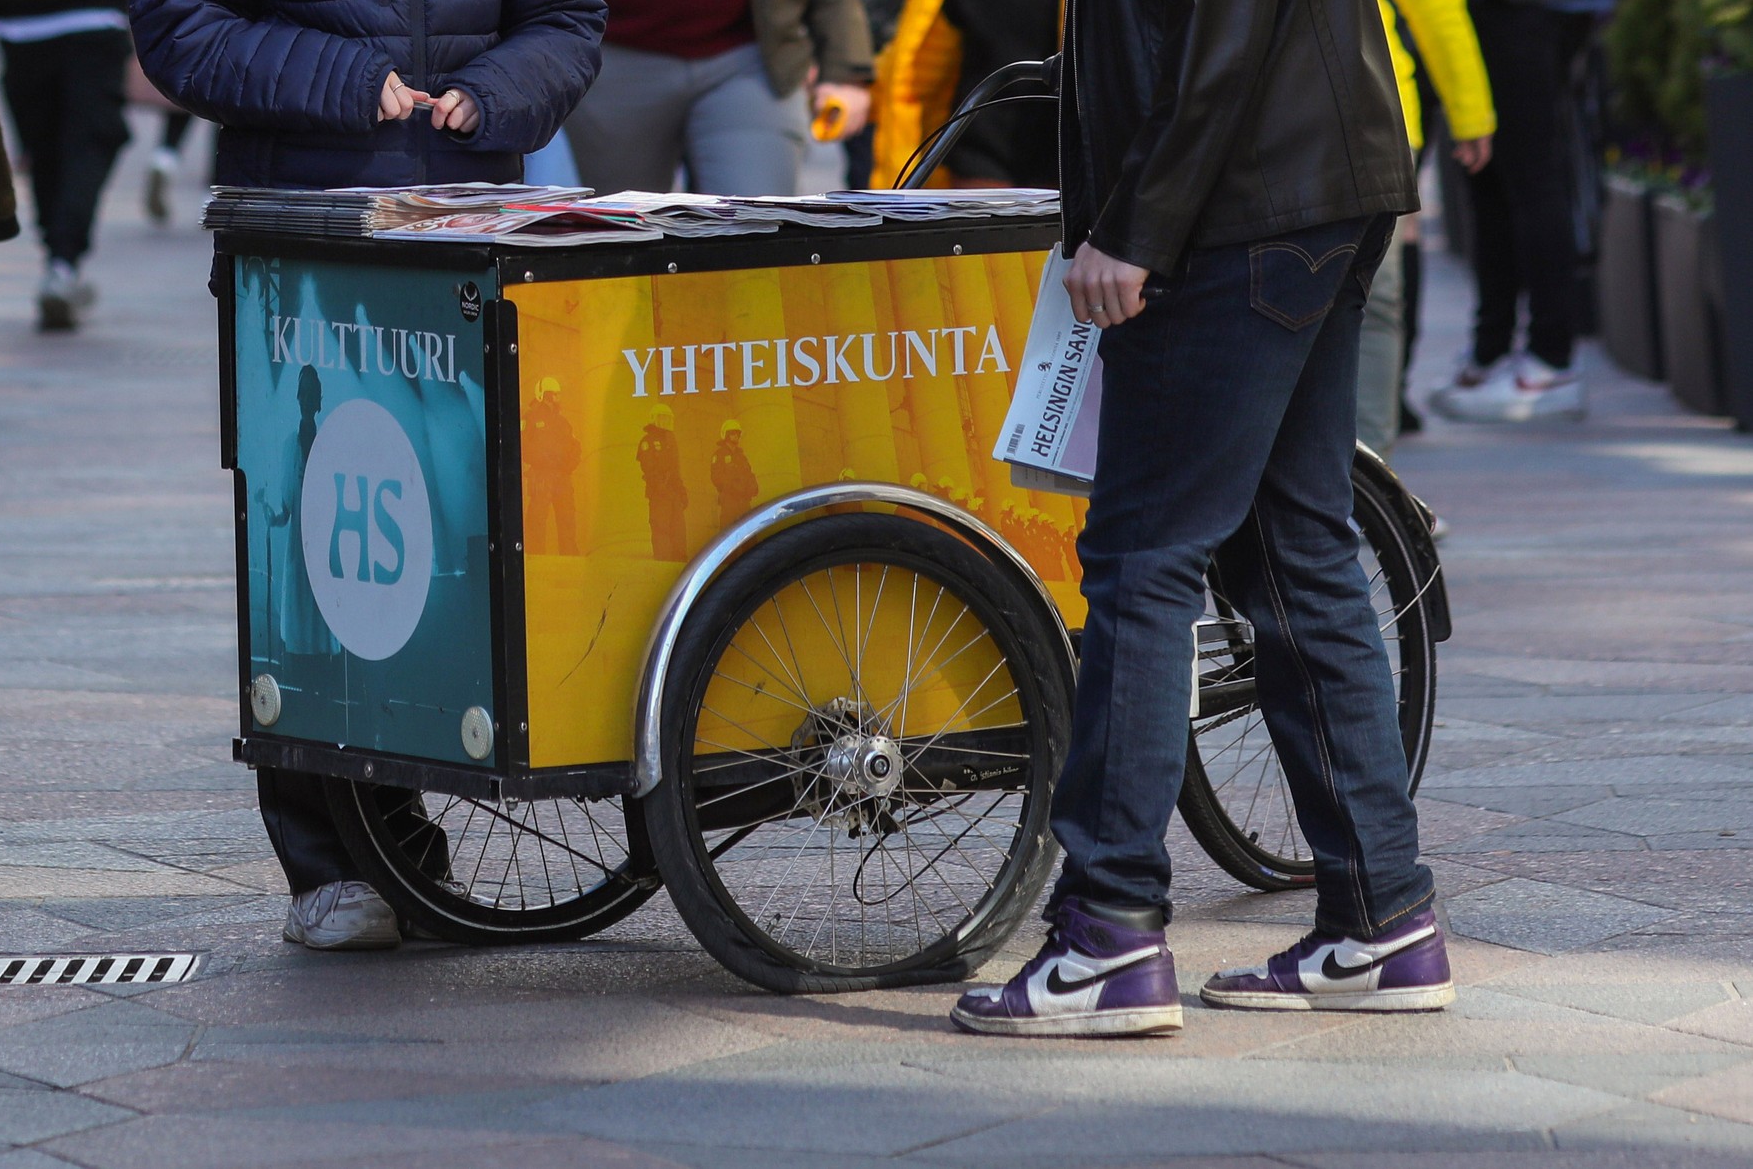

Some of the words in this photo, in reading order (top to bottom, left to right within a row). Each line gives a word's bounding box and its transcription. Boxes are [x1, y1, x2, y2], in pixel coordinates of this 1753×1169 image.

[461, 301, 480, 312] NORDIC
[271, 315, 457, 383] KULTTUURI
[621, 324, 1012, 398] YHTEISKUNTA
[1030, 364, 1079, 458] HELSINGIN
[328, 472, 406, 586] HS
